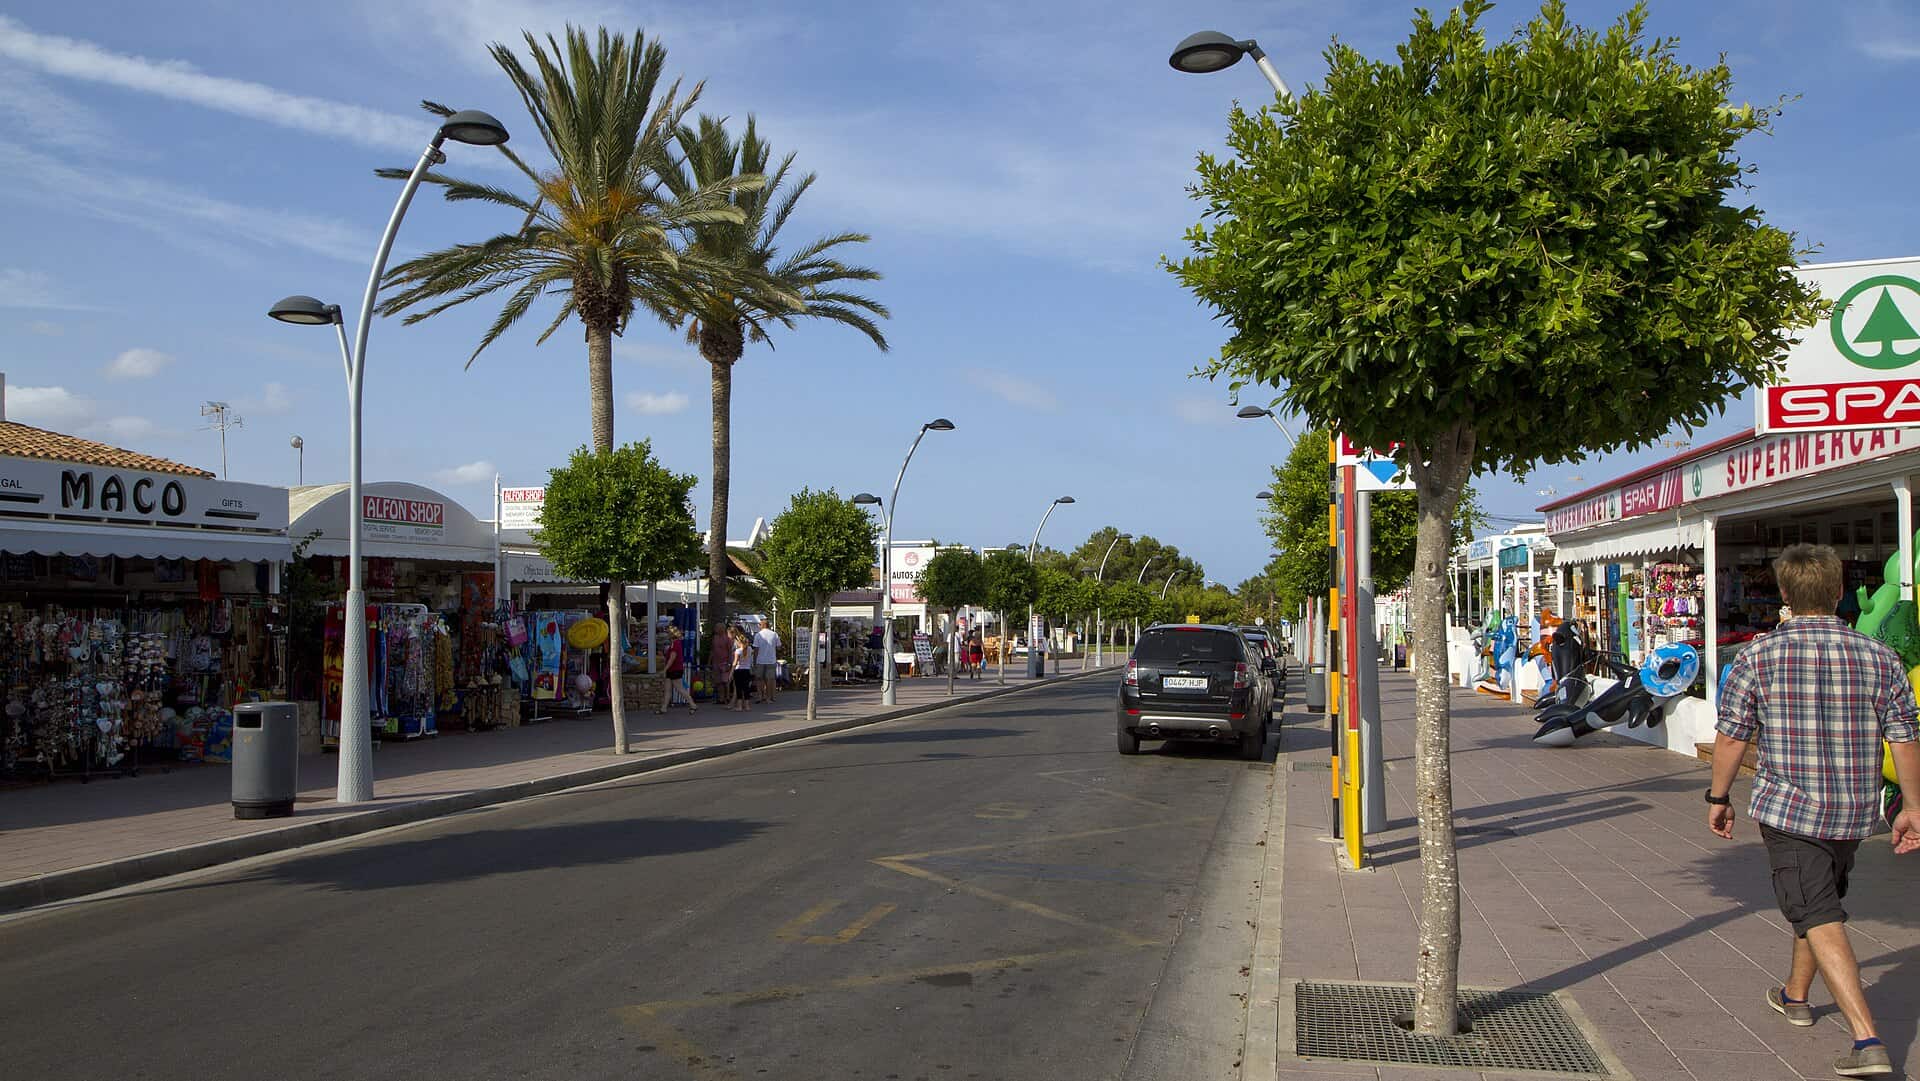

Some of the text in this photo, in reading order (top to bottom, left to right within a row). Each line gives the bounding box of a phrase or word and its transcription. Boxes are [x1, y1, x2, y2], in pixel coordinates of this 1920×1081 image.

[0, 478, 23, 489] GAL
[61, 470, 187, 517] MACO
[504, 490, 543, 502] ALFON SHOP
[1625, 484, 1655, 512] SPAR
[222, 499, 243, 509] GIFTS
[367, 497, 441, 523] ALFON SHOP
[1554, 495, 1608, 533] SUPERMARKET
[892, 571, 913, 580] AUTOS
